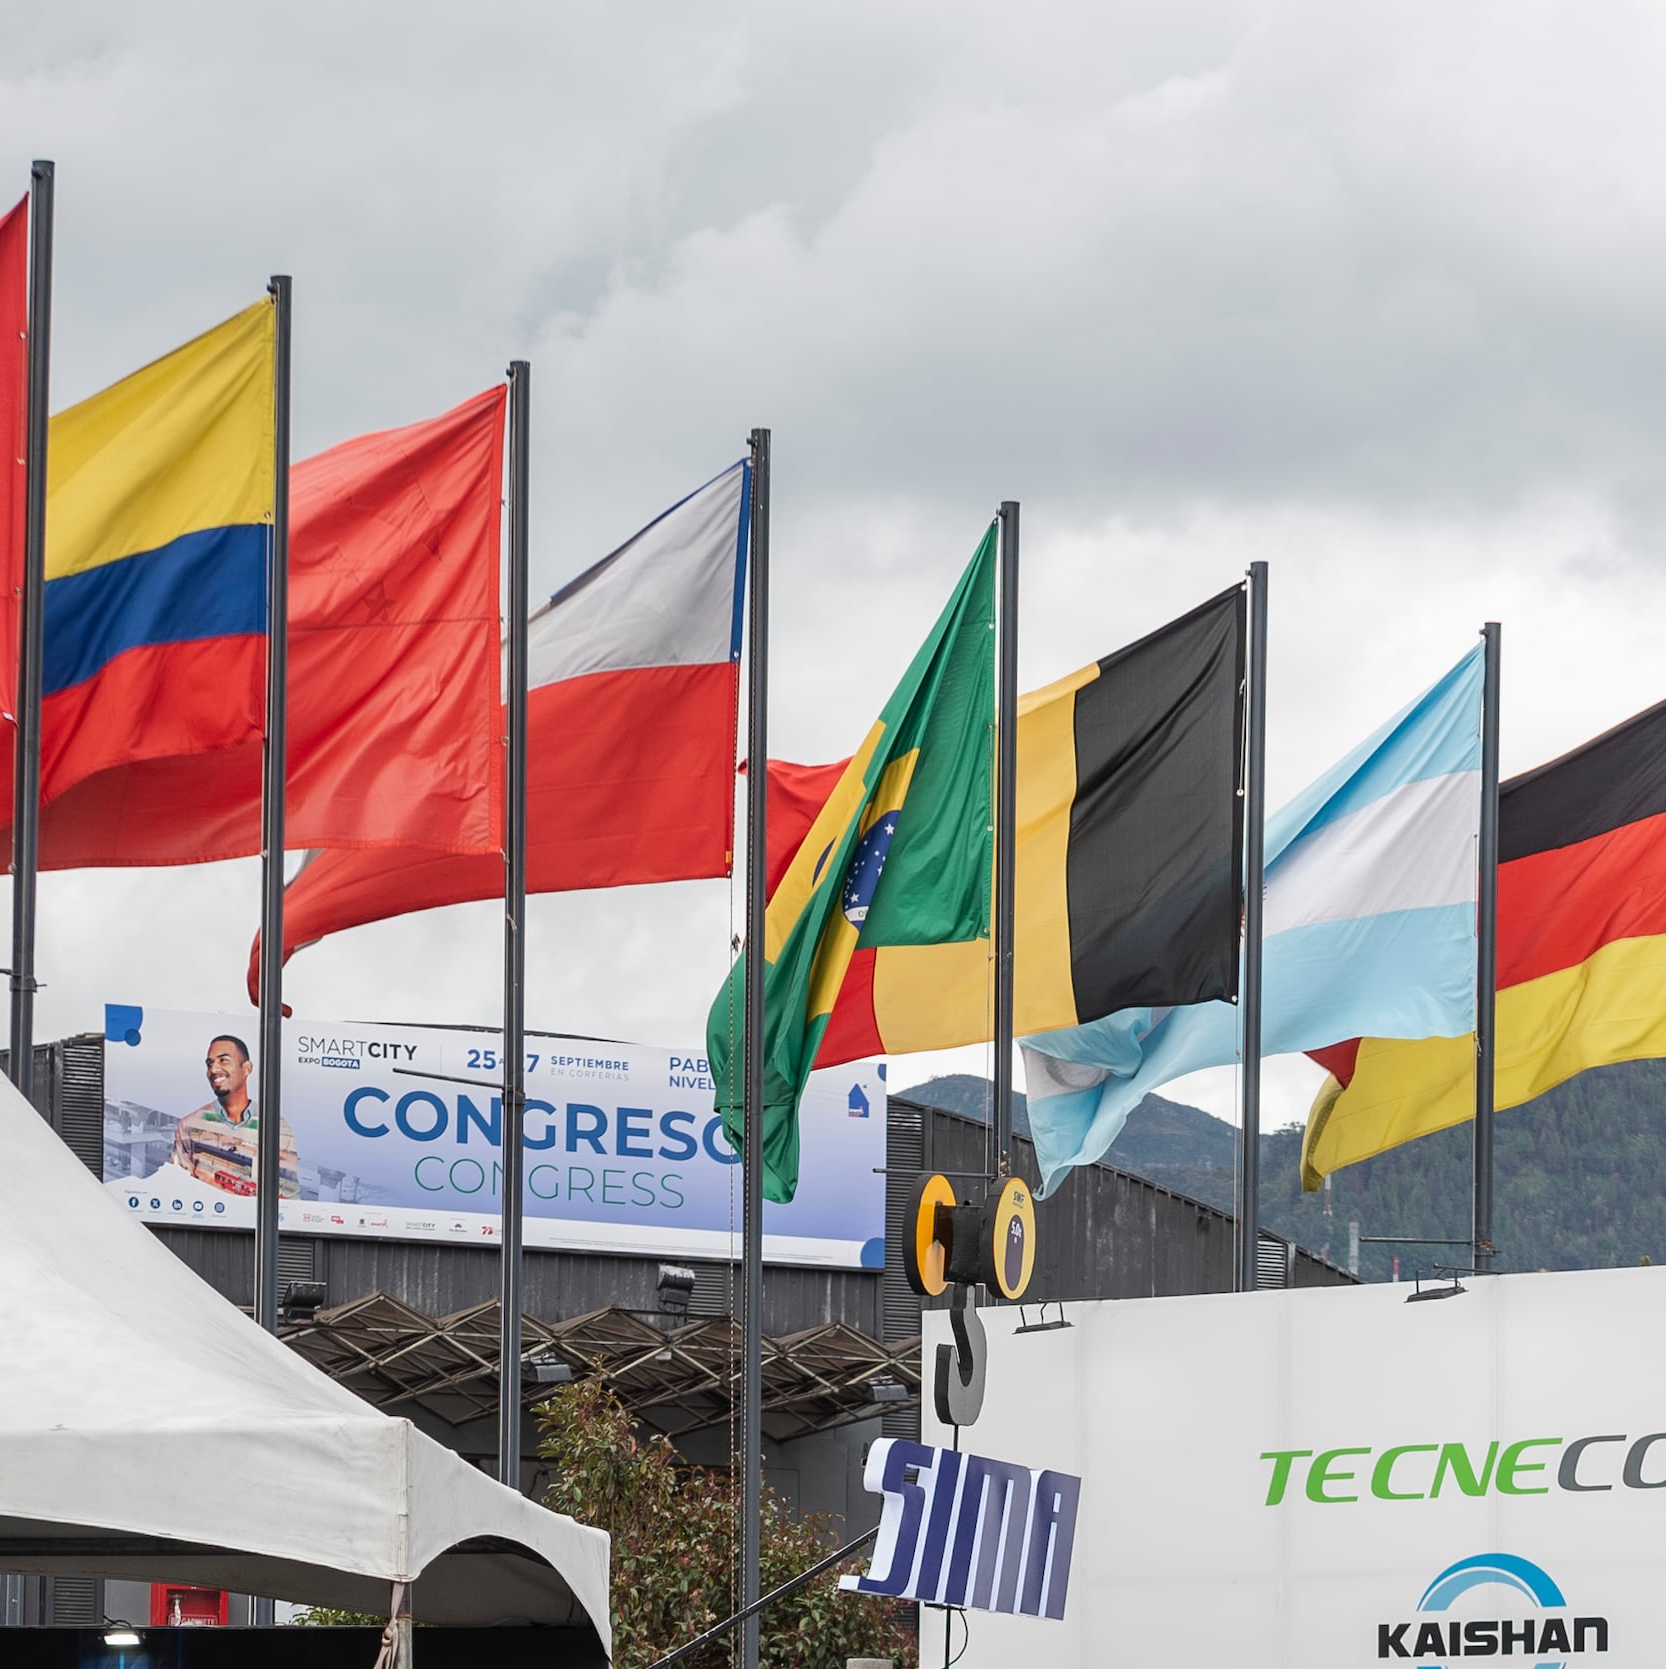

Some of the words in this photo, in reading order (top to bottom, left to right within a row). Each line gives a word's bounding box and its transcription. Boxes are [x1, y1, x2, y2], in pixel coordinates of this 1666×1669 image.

[466, 1049, 496, 1070] 25
[551, 1056, 629, 1070] SEPTIEMBRE
[550, 1068, 563, 1076] EN
[569, 1069, 629, 1081] CORFERIAS
[669, 1076, 716, 1090] NIVEL
[849, 1438, 1082, 1621] SIMA
[1378, 1617, 1608, 1658] KAISHAN
